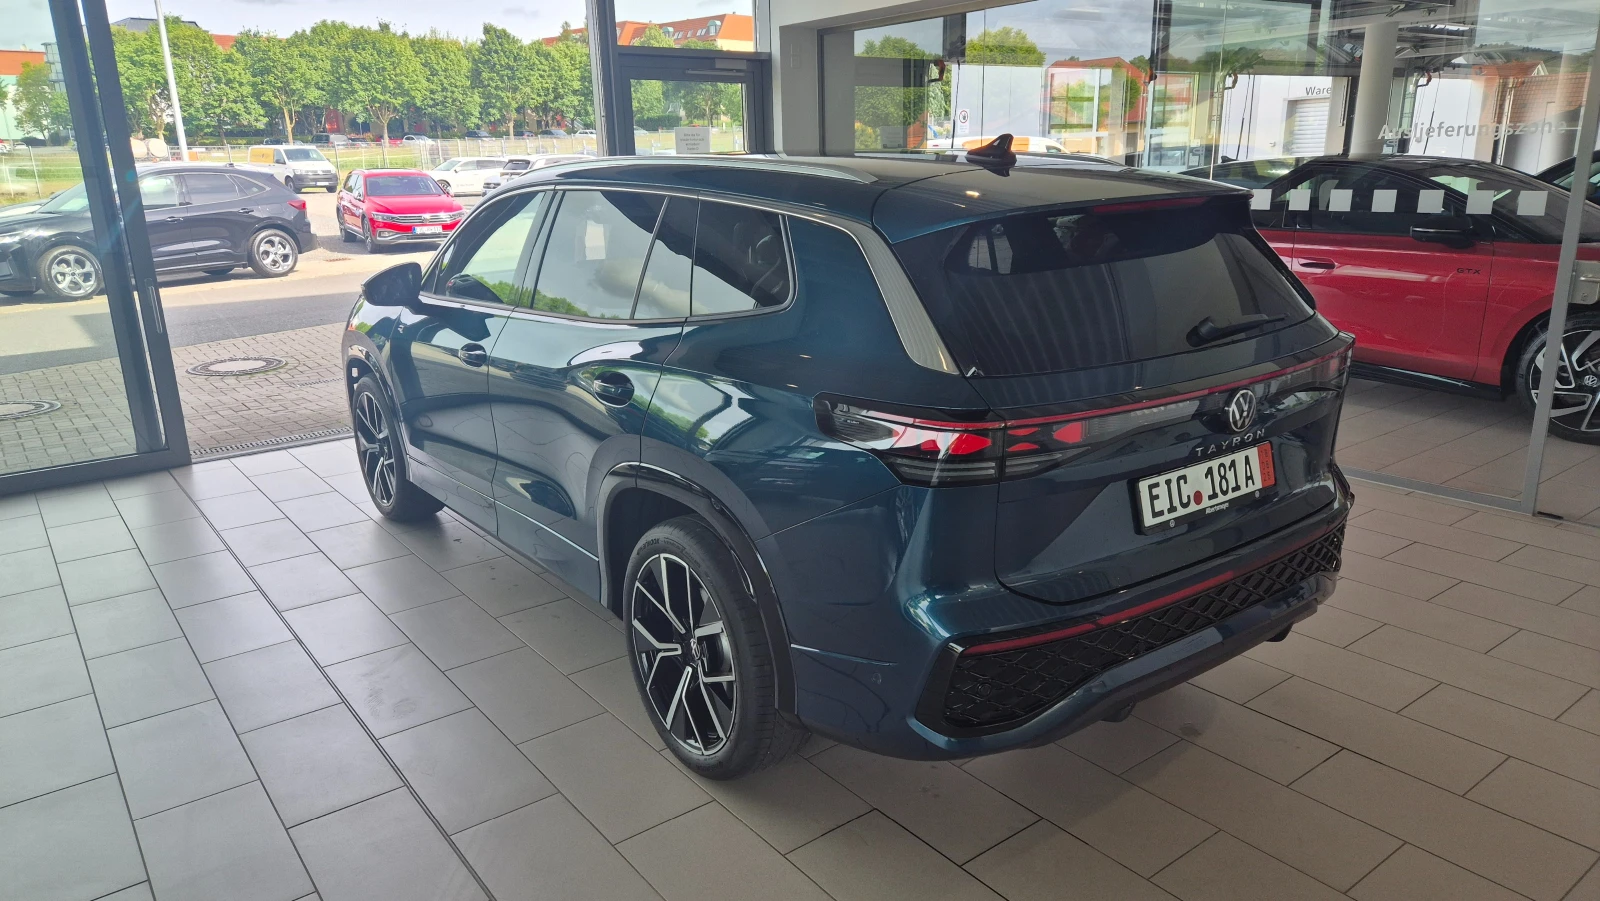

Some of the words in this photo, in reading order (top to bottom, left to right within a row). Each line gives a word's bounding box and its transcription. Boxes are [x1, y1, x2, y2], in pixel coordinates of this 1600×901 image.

[1456, 267, 1481, 275] GTX
[1195, 428, 1265, 457] TAYRON
[1147, 473, 1191, 519] EIC
